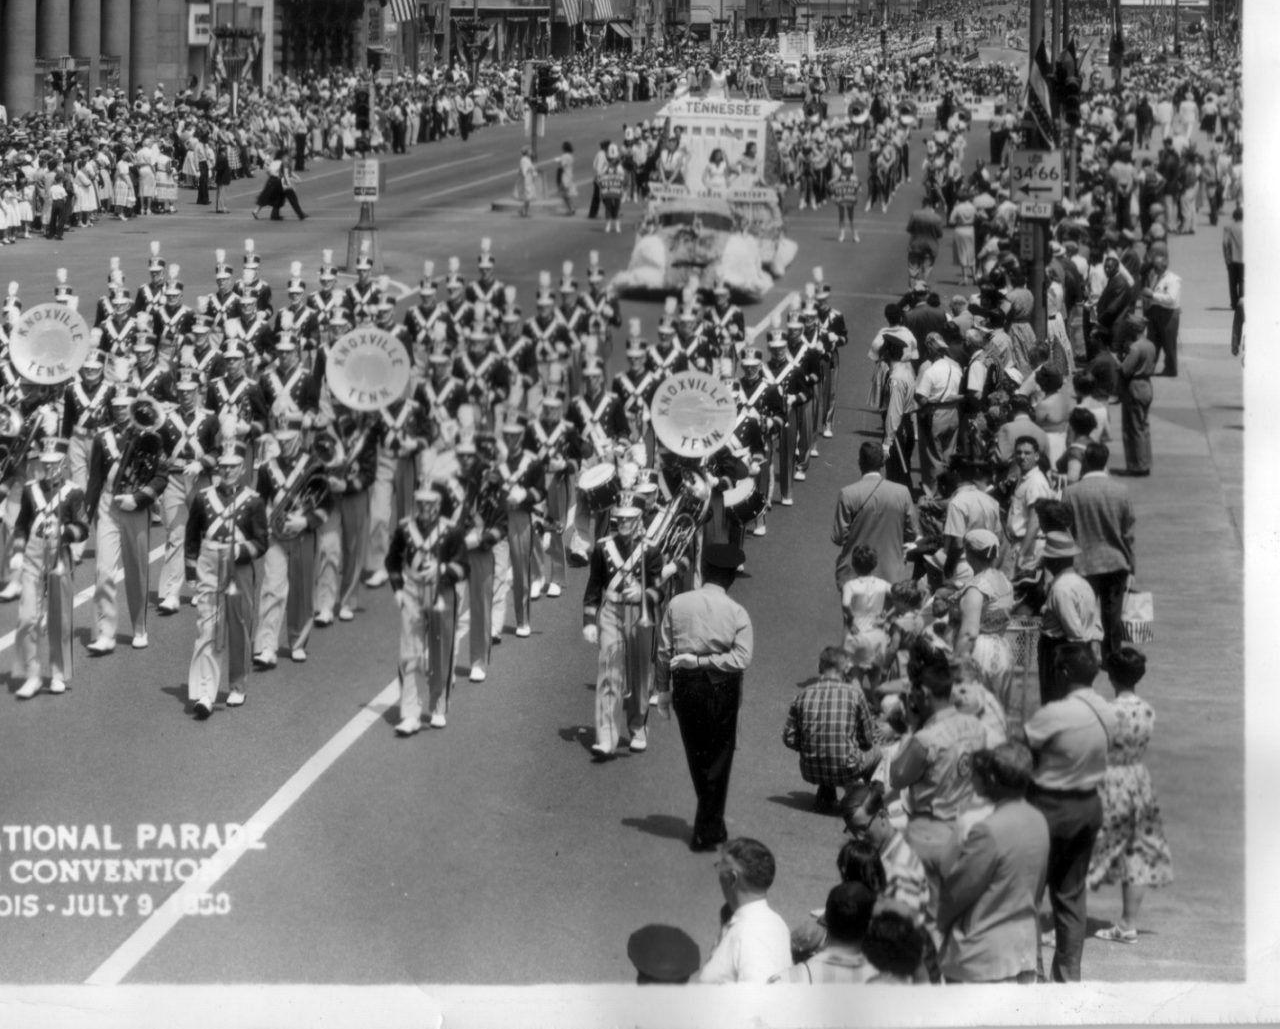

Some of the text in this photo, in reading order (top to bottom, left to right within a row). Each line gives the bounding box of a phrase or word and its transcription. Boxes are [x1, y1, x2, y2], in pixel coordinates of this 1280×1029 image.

[686, 101, 761, 116] TENNESSEE
[18, 308, 83, 342] KNOXVILLE
[333, 334, 404, 368] KNOXVILLE
[658, 378, 729, 415] KNOXVILLE
